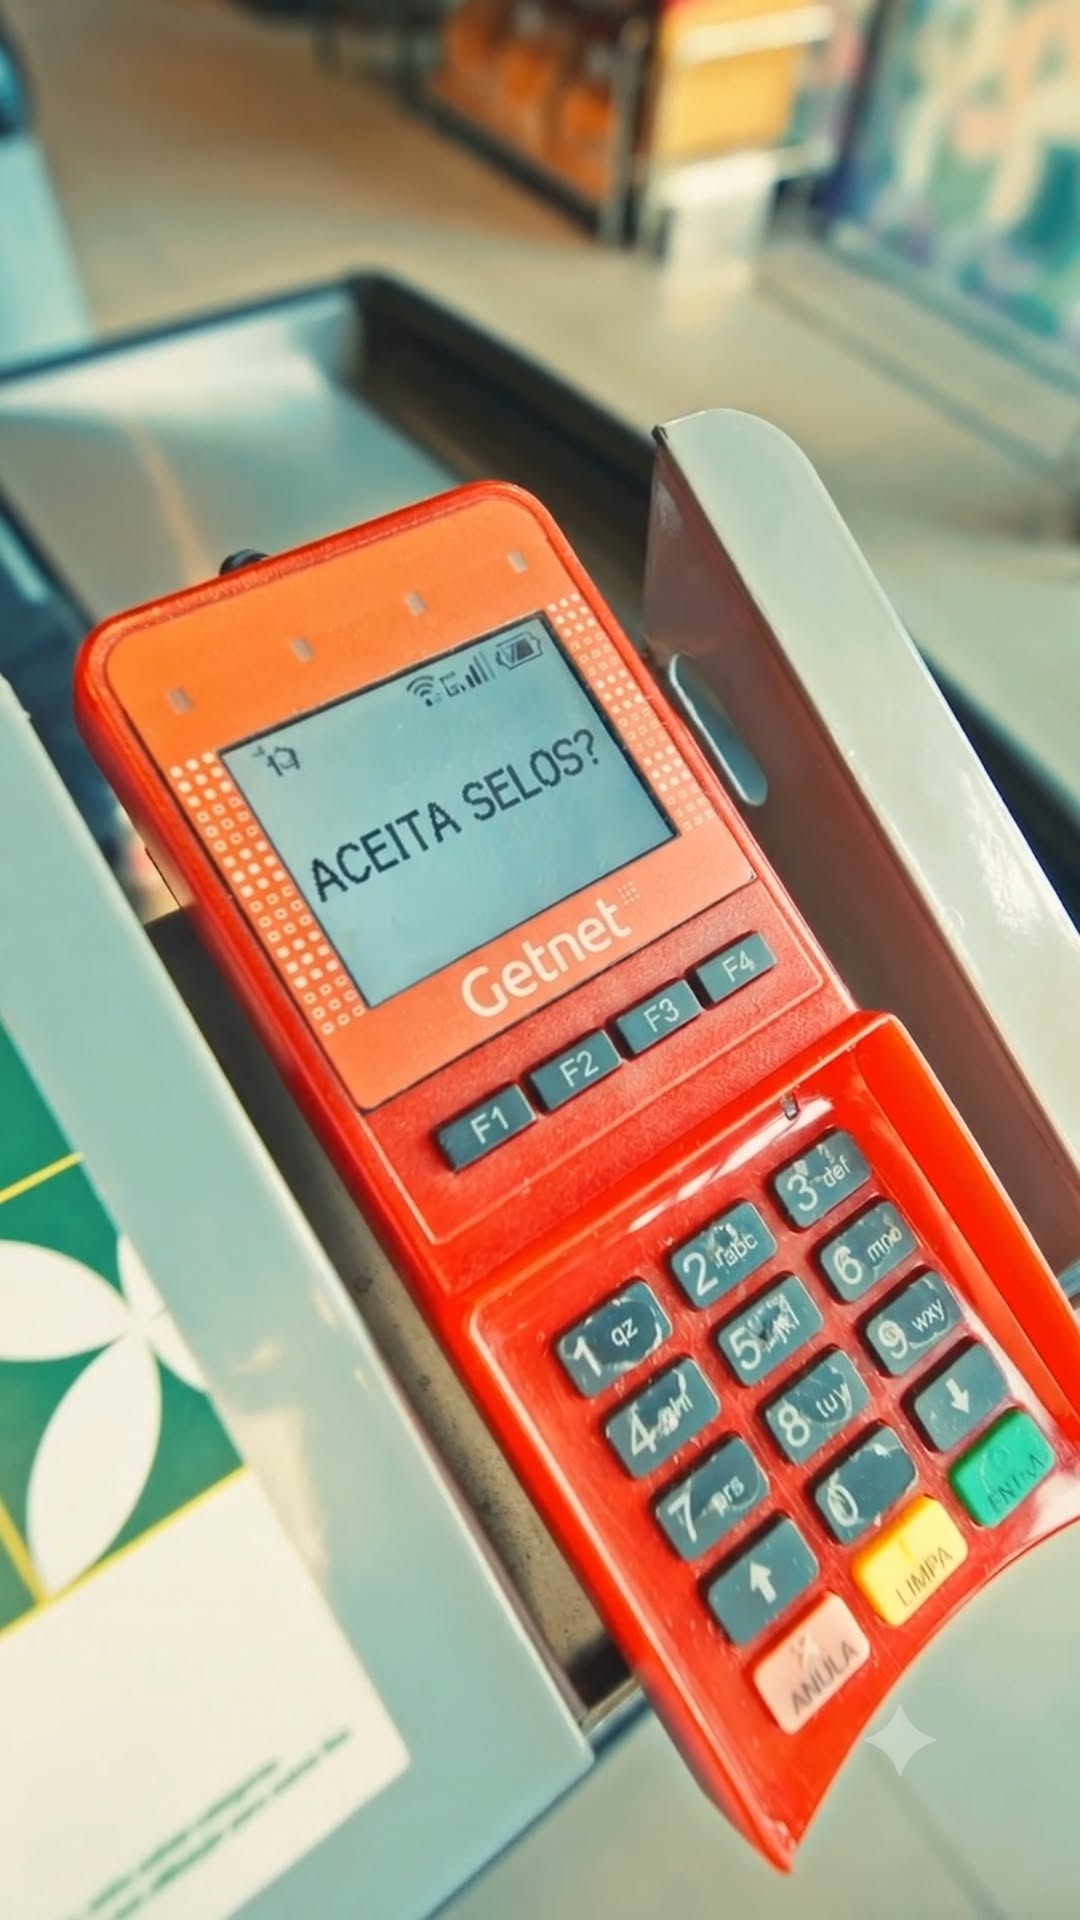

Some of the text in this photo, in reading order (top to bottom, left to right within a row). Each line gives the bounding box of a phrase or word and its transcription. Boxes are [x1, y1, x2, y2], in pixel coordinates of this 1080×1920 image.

[310, 728, 602, 903] ACEITA SELOS?
[461, 897, 632, 1018] Getnet
[721, 949, 756, 983] F4
[643, 997, 680, 1033] F3
[558, 1049, 600, 1088] F2
[469, 1109, 509, 1145] F1
[787, 1173, 818, 1212] 3
[682, 1251, 719, 1297] 2
[833, 1245, 863, 1285] 6
[573, 1317, 639, 1377] 1 qz
[729, 1326, 761, 1370] 5
[877, 1299, 946, 1360] 9 wxy
[631, 1410, 657, 1456] 4
[778, 1402, 811, 1448] 8
[667, 1490, 698, 1543] 7
[895, 1545, 954, 1607] LIMPA
[790, 1640, 859, 1717] ANULA
